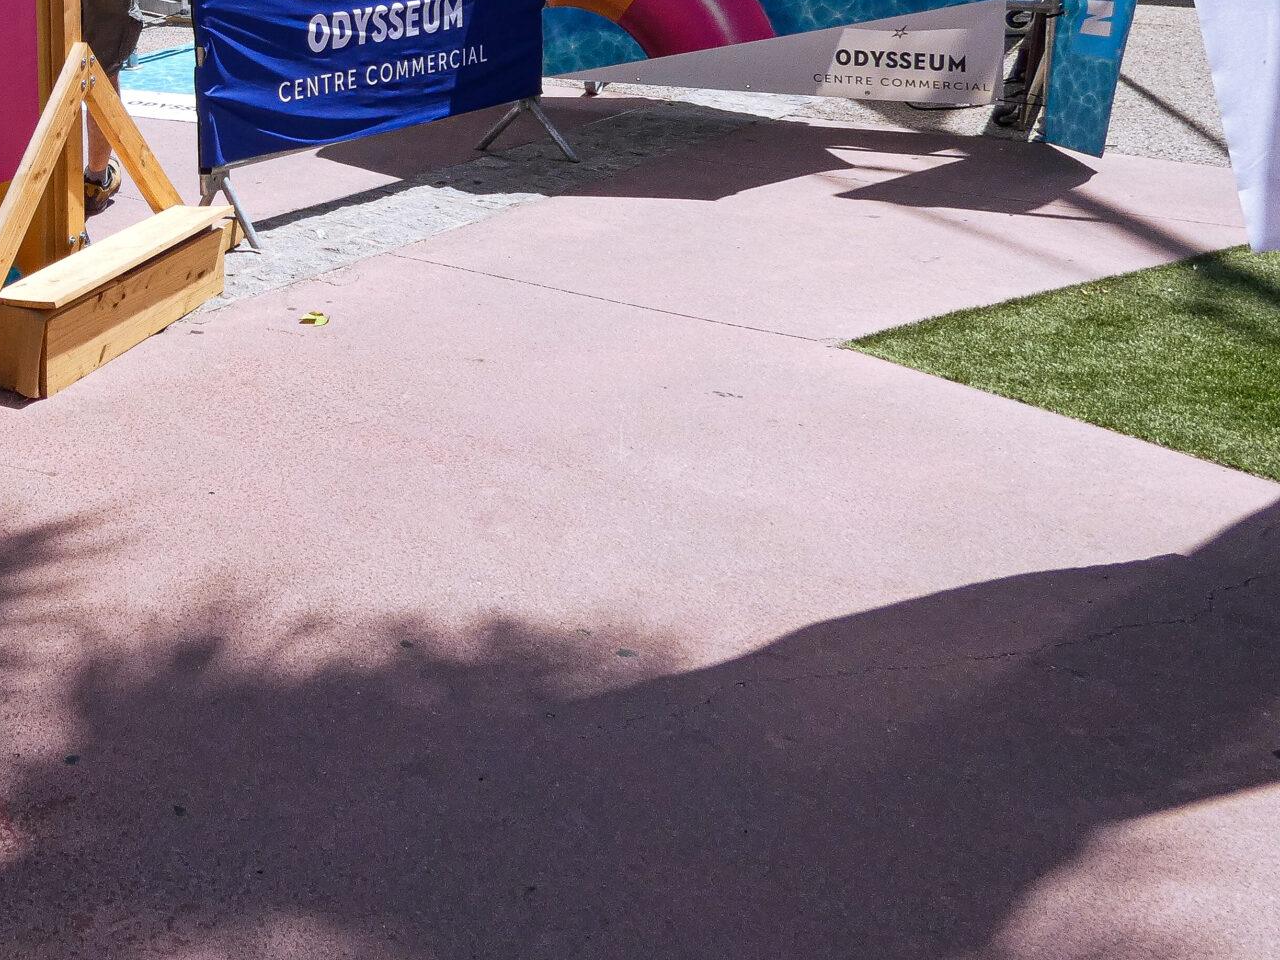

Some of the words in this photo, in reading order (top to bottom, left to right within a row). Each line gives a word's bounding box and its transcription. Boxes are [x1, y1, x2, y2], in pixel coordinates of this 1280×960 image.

[835, 49, 967, 73] ODYSSEUM
[278, 68, 358, 103] CENTRE
[365, 45, 489, 86] COMMERCIAL
[813, 73, 874, 86] CENTRE
[880, 77, 992, 93] COMMERCIAL
